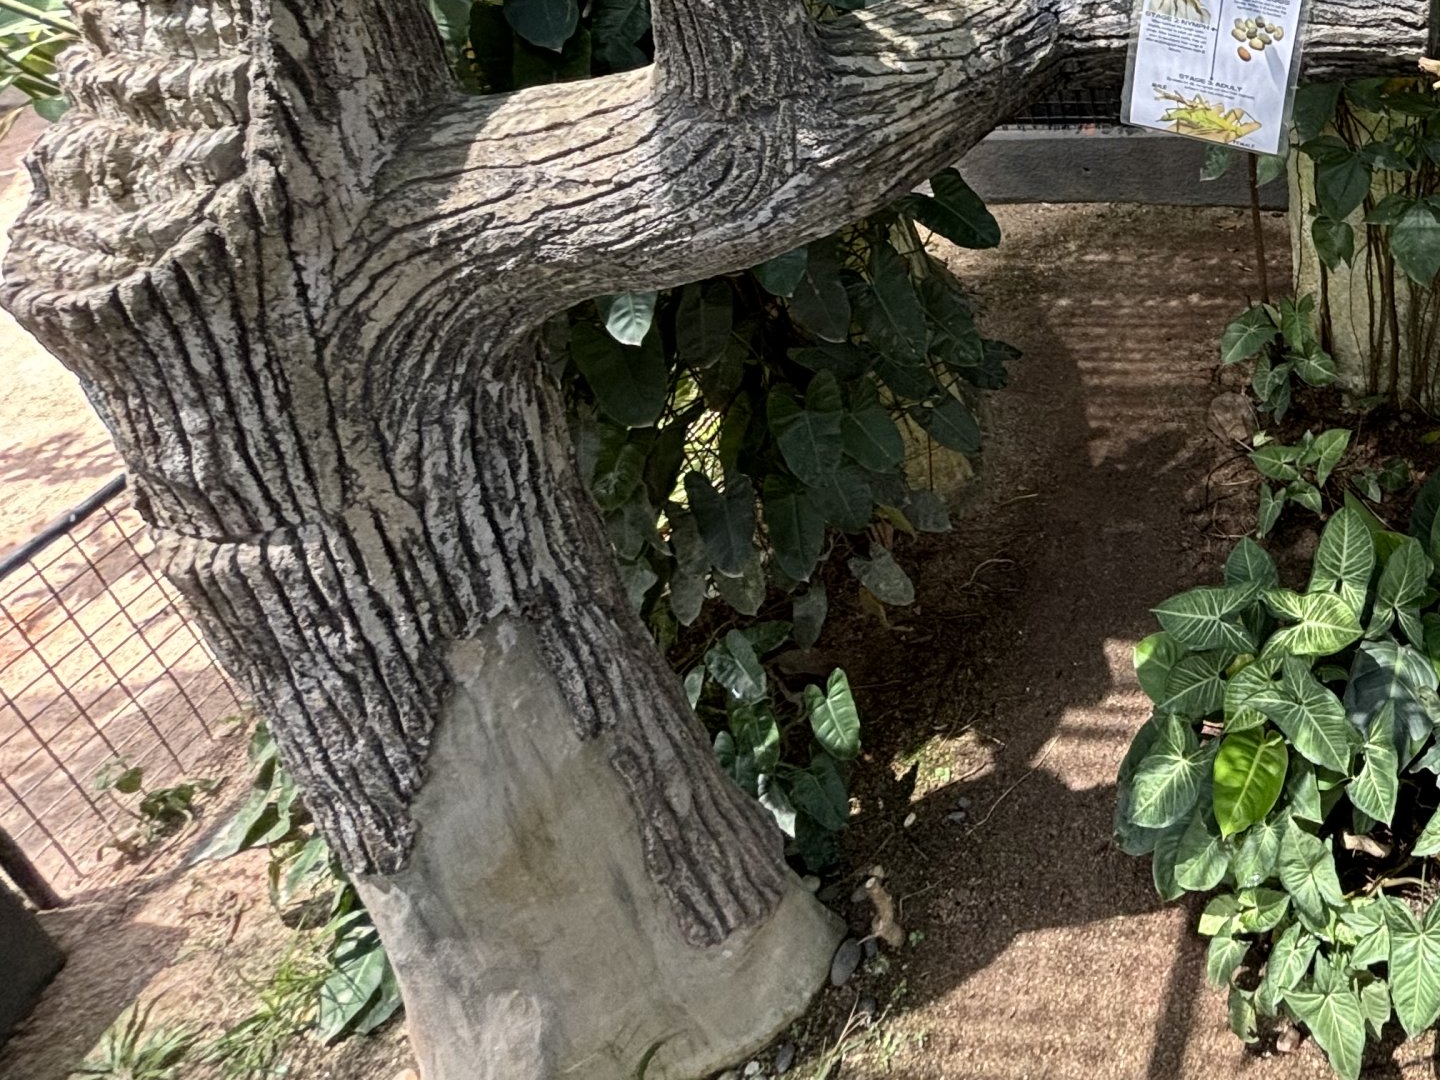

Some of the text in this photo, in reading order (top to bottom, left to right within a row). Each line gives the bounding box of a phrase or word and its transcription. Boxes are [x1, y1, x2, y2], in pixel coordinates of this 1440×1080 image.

[1145, 10, 1172, 22] STAGE
[1181, 19, 1211, 31] NYMPH
[1178, 73, 1206, 85] STAGE
[1215, 82, 1243, 92] ADULT
